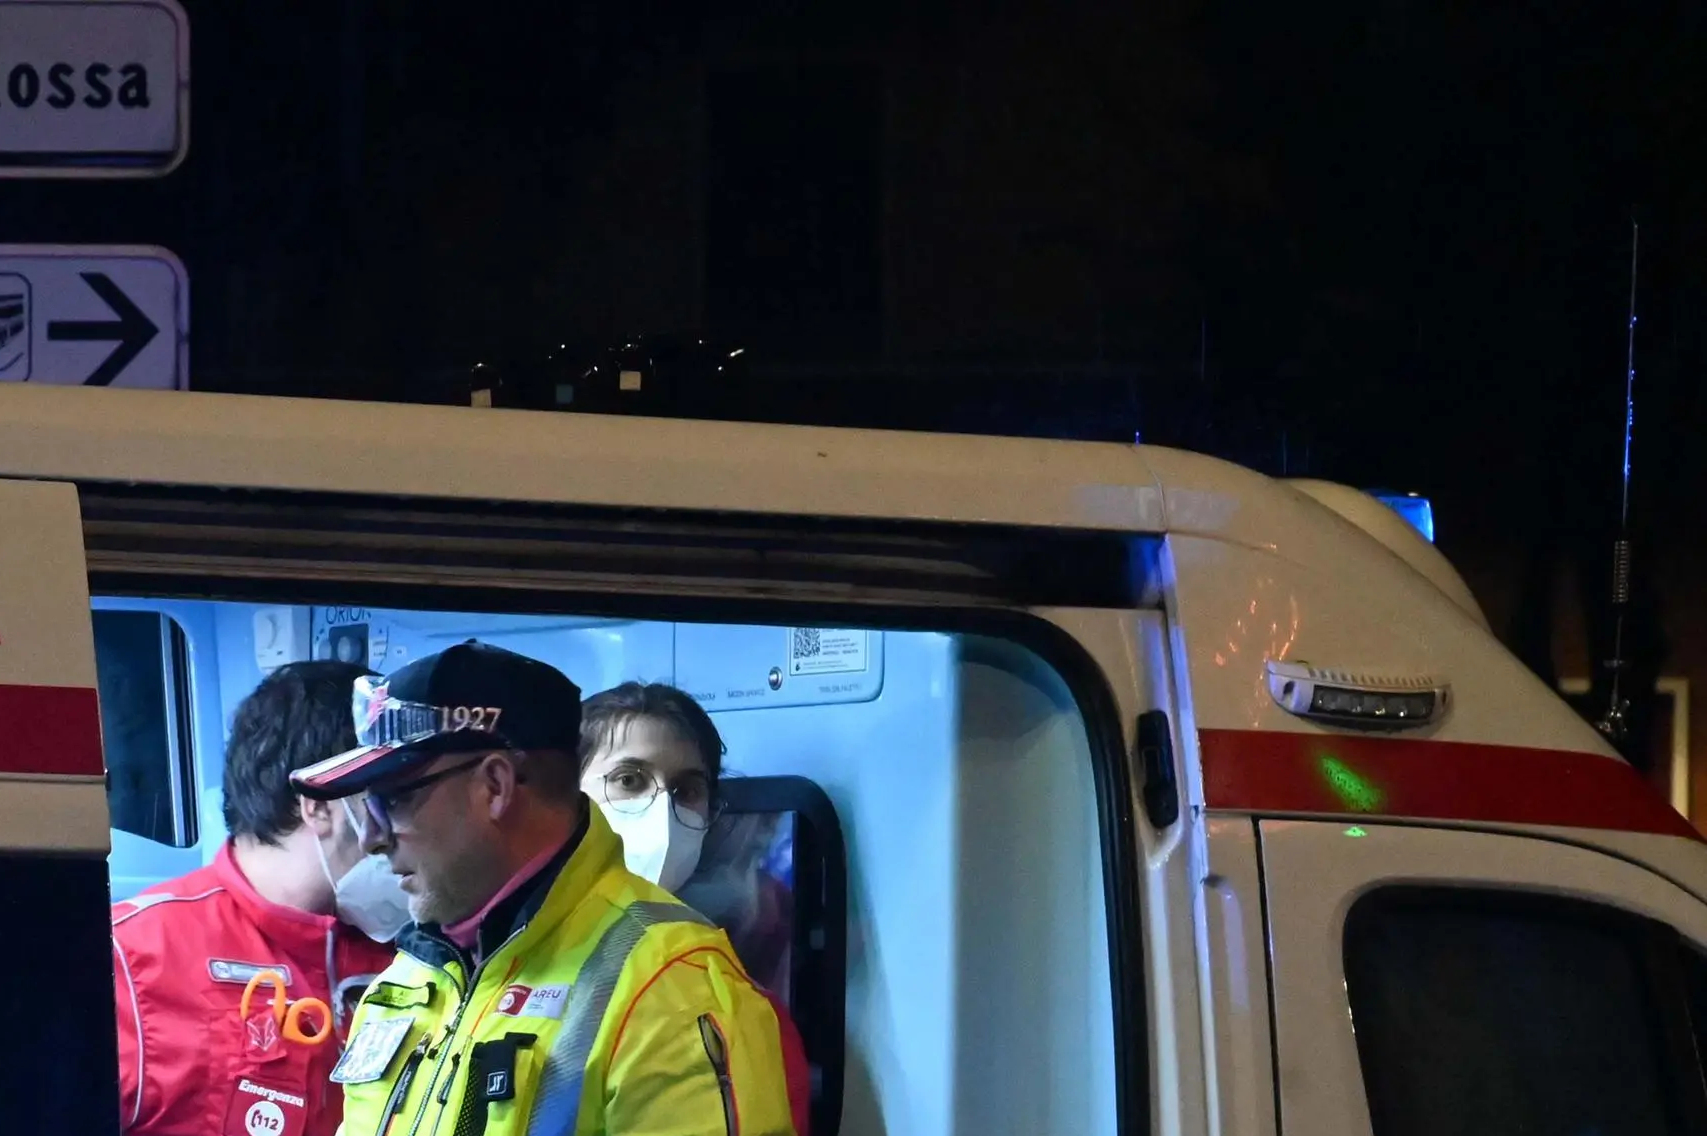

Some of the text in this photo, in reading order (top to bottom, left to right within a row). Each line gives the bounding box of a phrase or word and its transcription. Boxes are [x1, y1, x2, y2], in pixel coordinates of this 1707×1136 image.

[441, 704, 502, 734] 1927
[238, 1079, 305, 1108] Emergenza
[257, 1114, 279, 1130] 112
